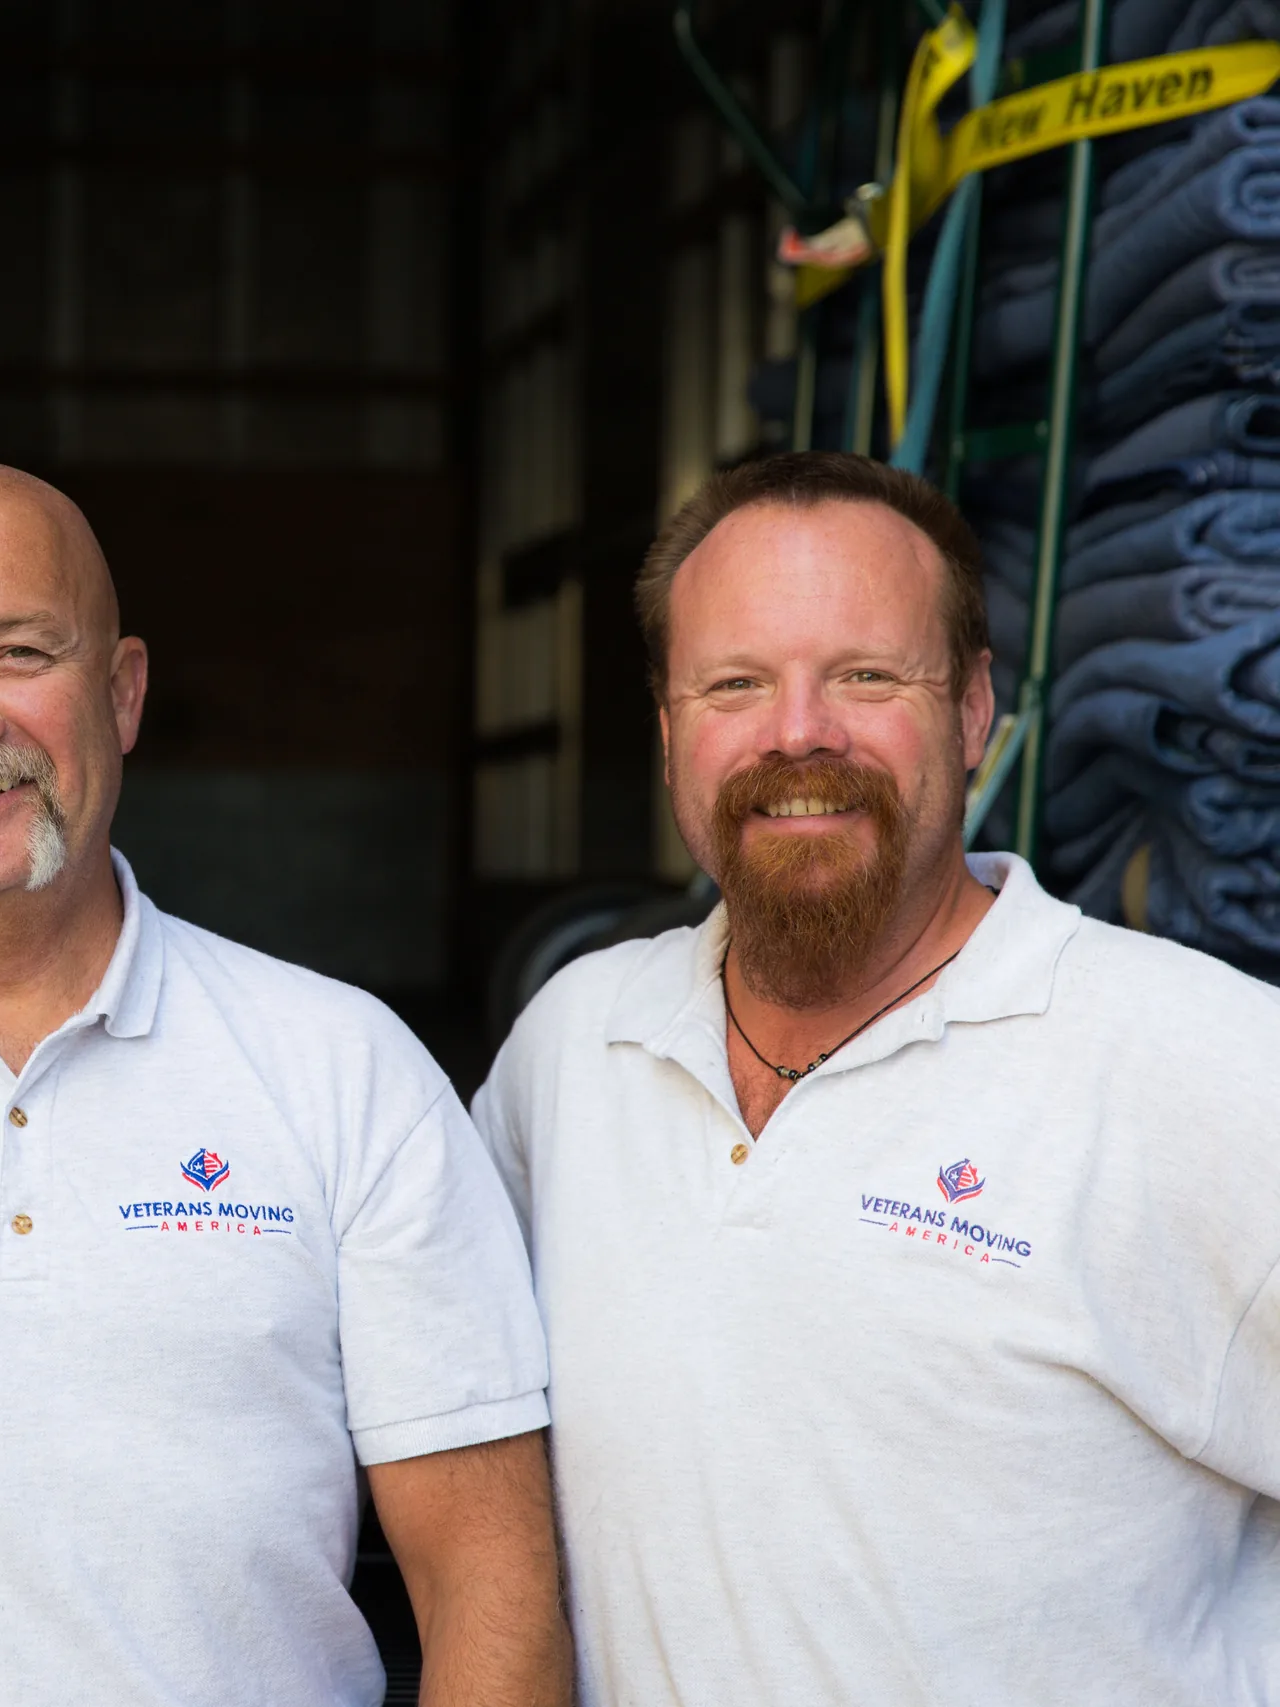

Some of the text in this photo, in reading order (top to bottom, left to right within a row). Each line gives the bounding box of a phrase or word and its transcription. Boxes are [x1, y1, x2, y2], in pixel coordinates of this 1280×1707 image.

[976, 63, 1215, 148] New Haven
[118, 1201, 295, 1223] VETERANS MOVING
[160, 1221, 262, 1236] AMERICA
[861, 1194, 1032, 1257] VETERANS MOVING
[888, 1222, 990, 1264] AMERICA
